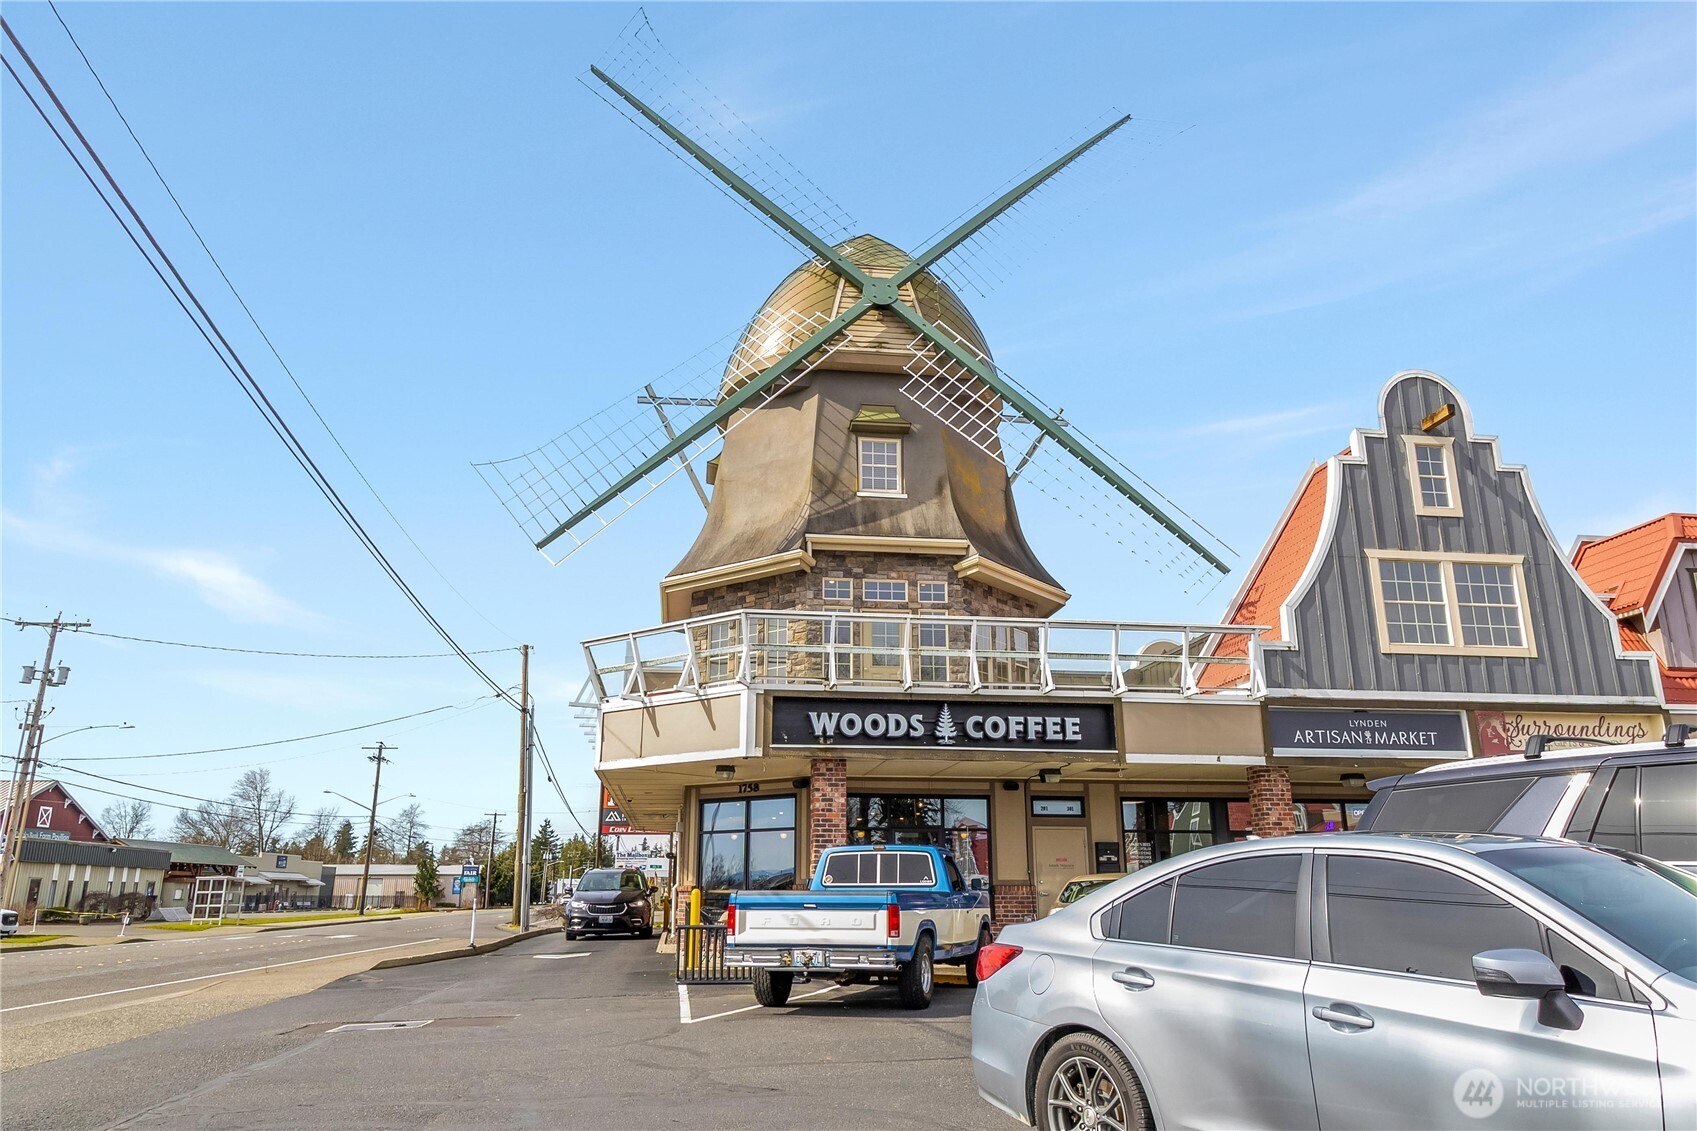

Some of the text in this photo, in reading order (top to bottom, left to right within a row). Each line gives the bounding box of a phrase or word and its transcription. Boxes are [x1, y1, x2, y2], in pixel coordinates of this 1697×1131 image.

[809, 712, 1082, 742] WOODS COFFEE
[1349, 720, 1387, 728] LYNDEN
[1506, 714, 1648, 745] Surroundings
[1294, 730, 1437, 746] ARTISAN MARKET
[738, 783, 760, 793] 1758
[761, 918, 863, 926] FORD
